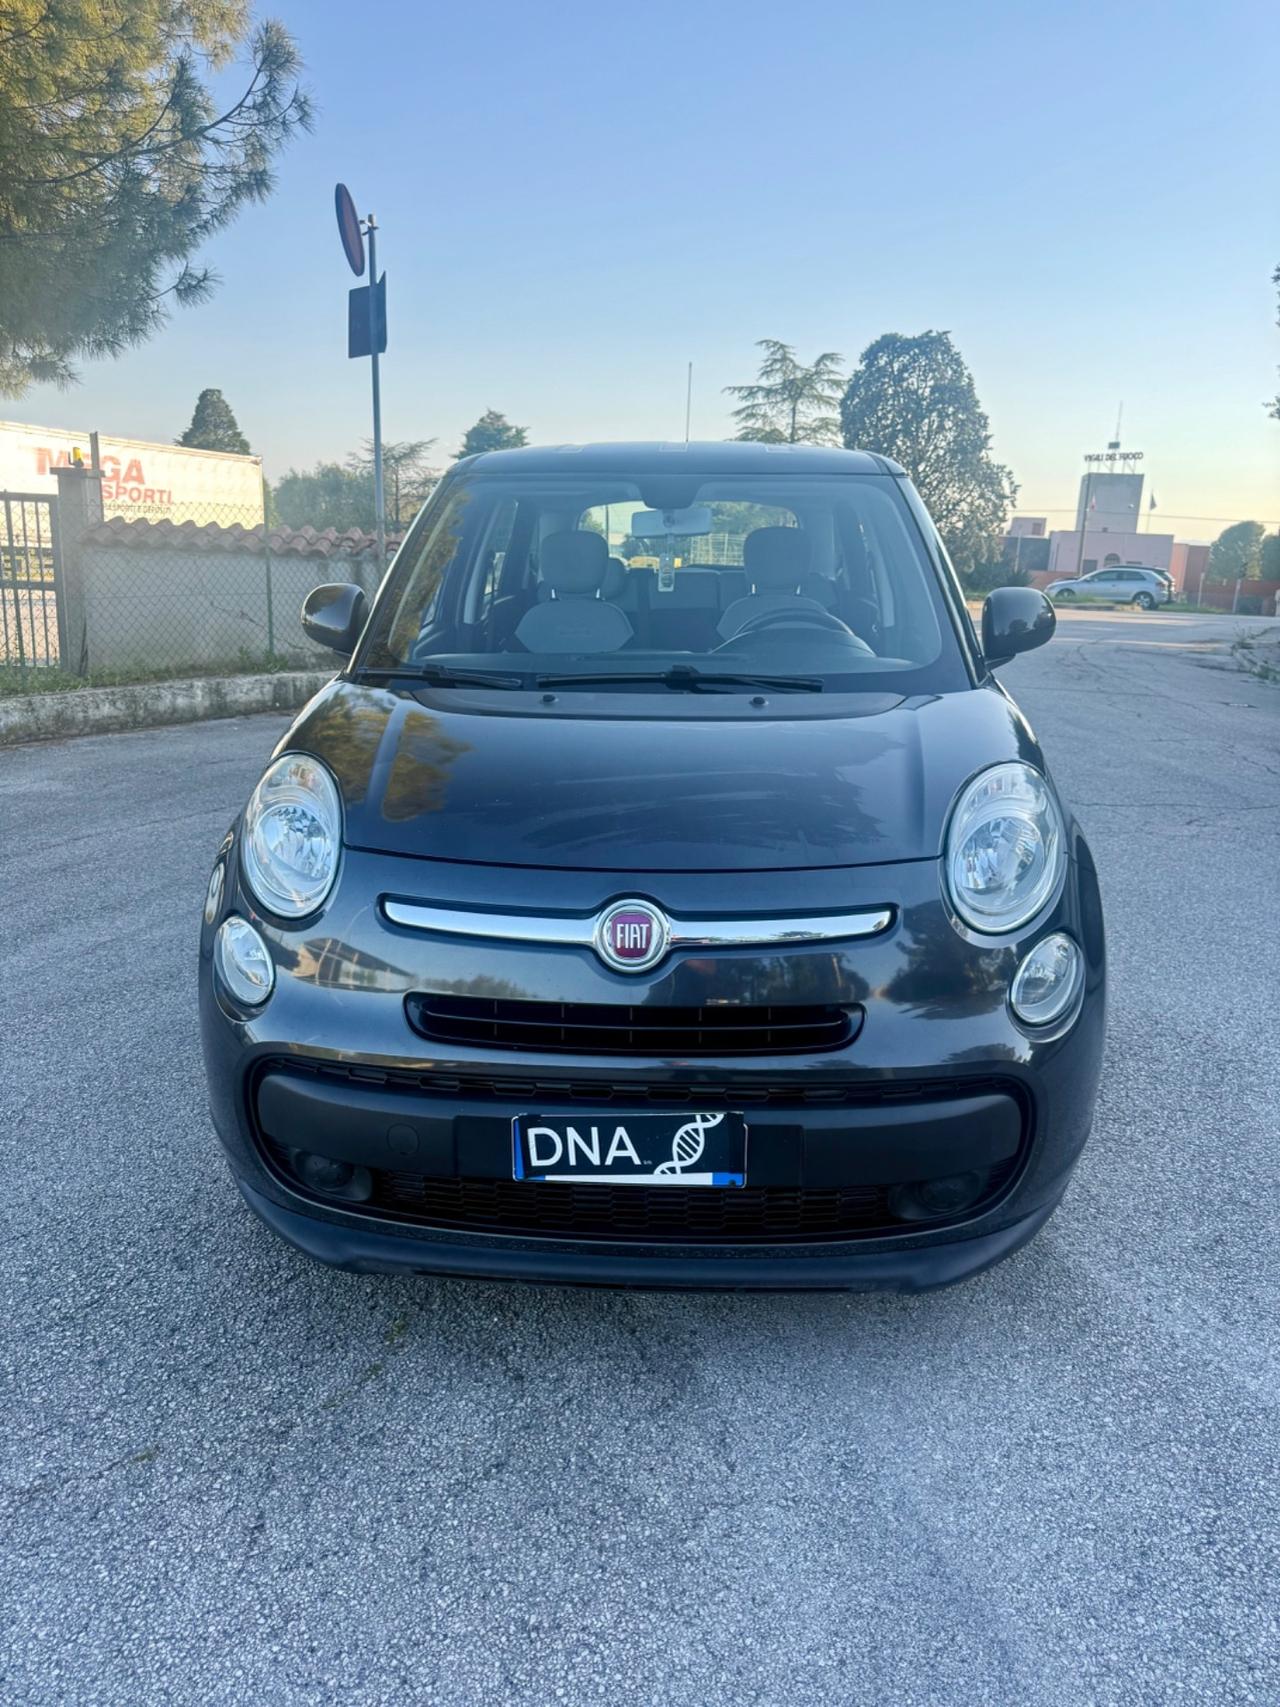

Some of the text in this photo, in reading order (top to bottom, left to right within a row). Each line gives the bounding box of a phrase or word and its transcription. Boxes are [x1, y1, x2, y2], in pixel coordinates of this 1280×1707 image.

[1119, 451, 1144, 461] FUOCO
[616, 924, 650, 949] FIAT
[527, 1126, 642, 1167] DNA
